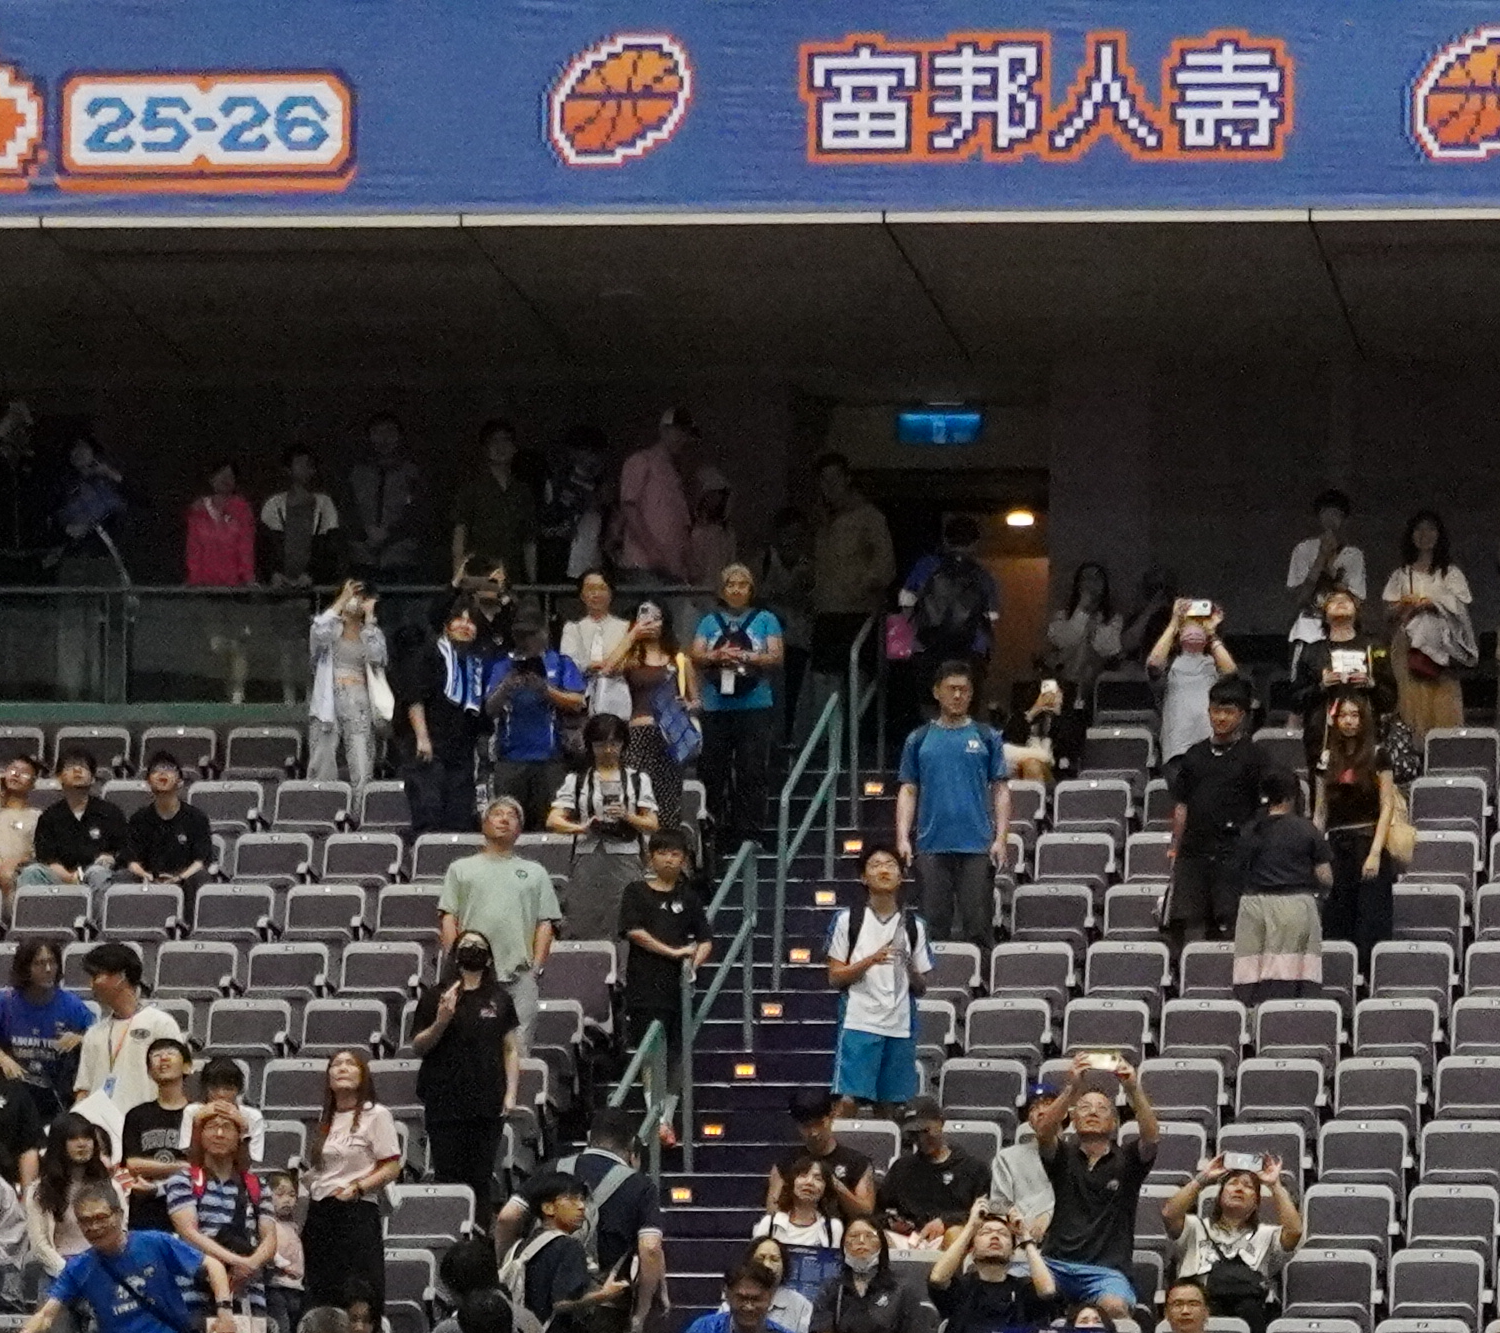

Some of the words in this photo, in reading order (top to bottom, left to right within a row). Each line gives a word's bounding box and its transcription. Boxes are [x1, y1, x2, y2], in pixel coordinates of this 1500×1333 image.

[80, 92, 334, 154] 25-26
[812, 44, 1284, 150] 富邦人壽
